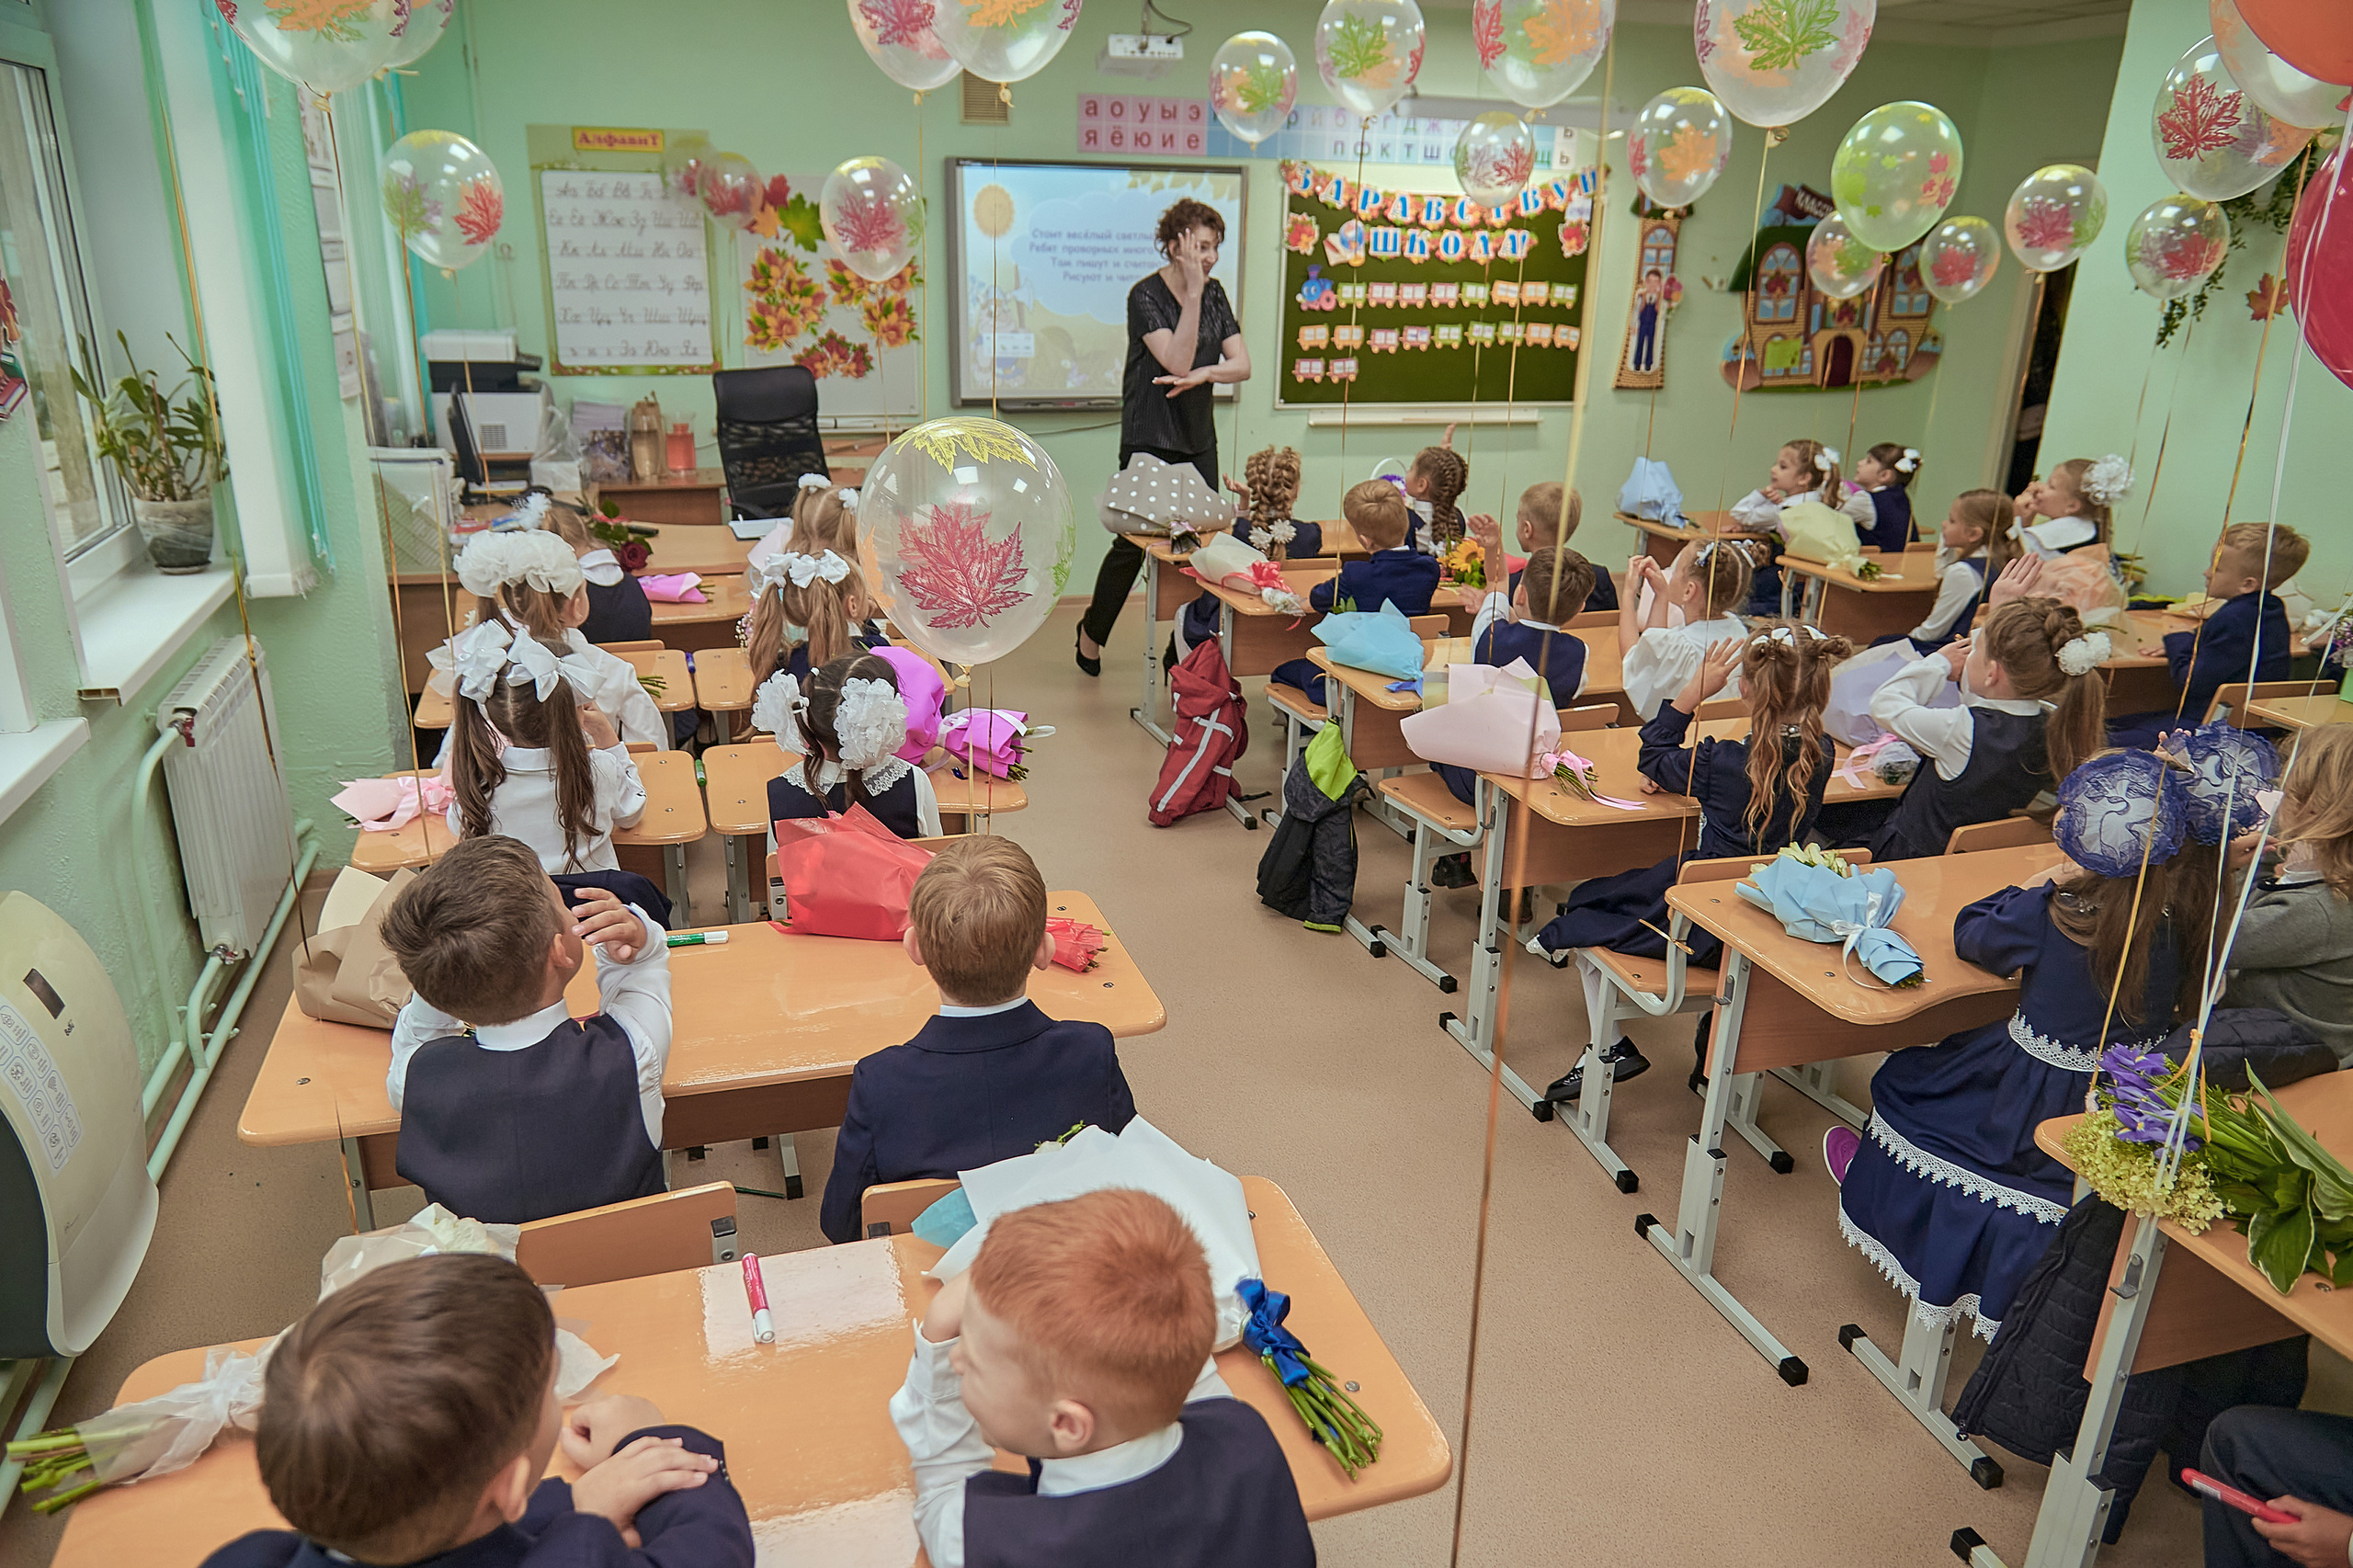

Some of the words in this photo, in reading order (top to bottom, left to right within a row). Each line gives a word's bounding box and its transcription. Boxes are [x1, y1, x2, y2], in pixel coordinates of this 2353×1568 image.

[1085, 99, 1098, 117] а
[1110, 100, 1125, 119] о
[1138, 102, 1150, 122] у
[1161, 103, 1177, 120] ы
[1188, 104, 1200, 120] э
[1085, 129, 1097, 146] я
[1110, 125, 1124, 147] ё
[1134, 131, 1152, 148] ю
[1162, 131, 1175, 148] и
[1187, 132, 1199, 150] е
[1369, 227, 1530, 260] ШКОЛА!
